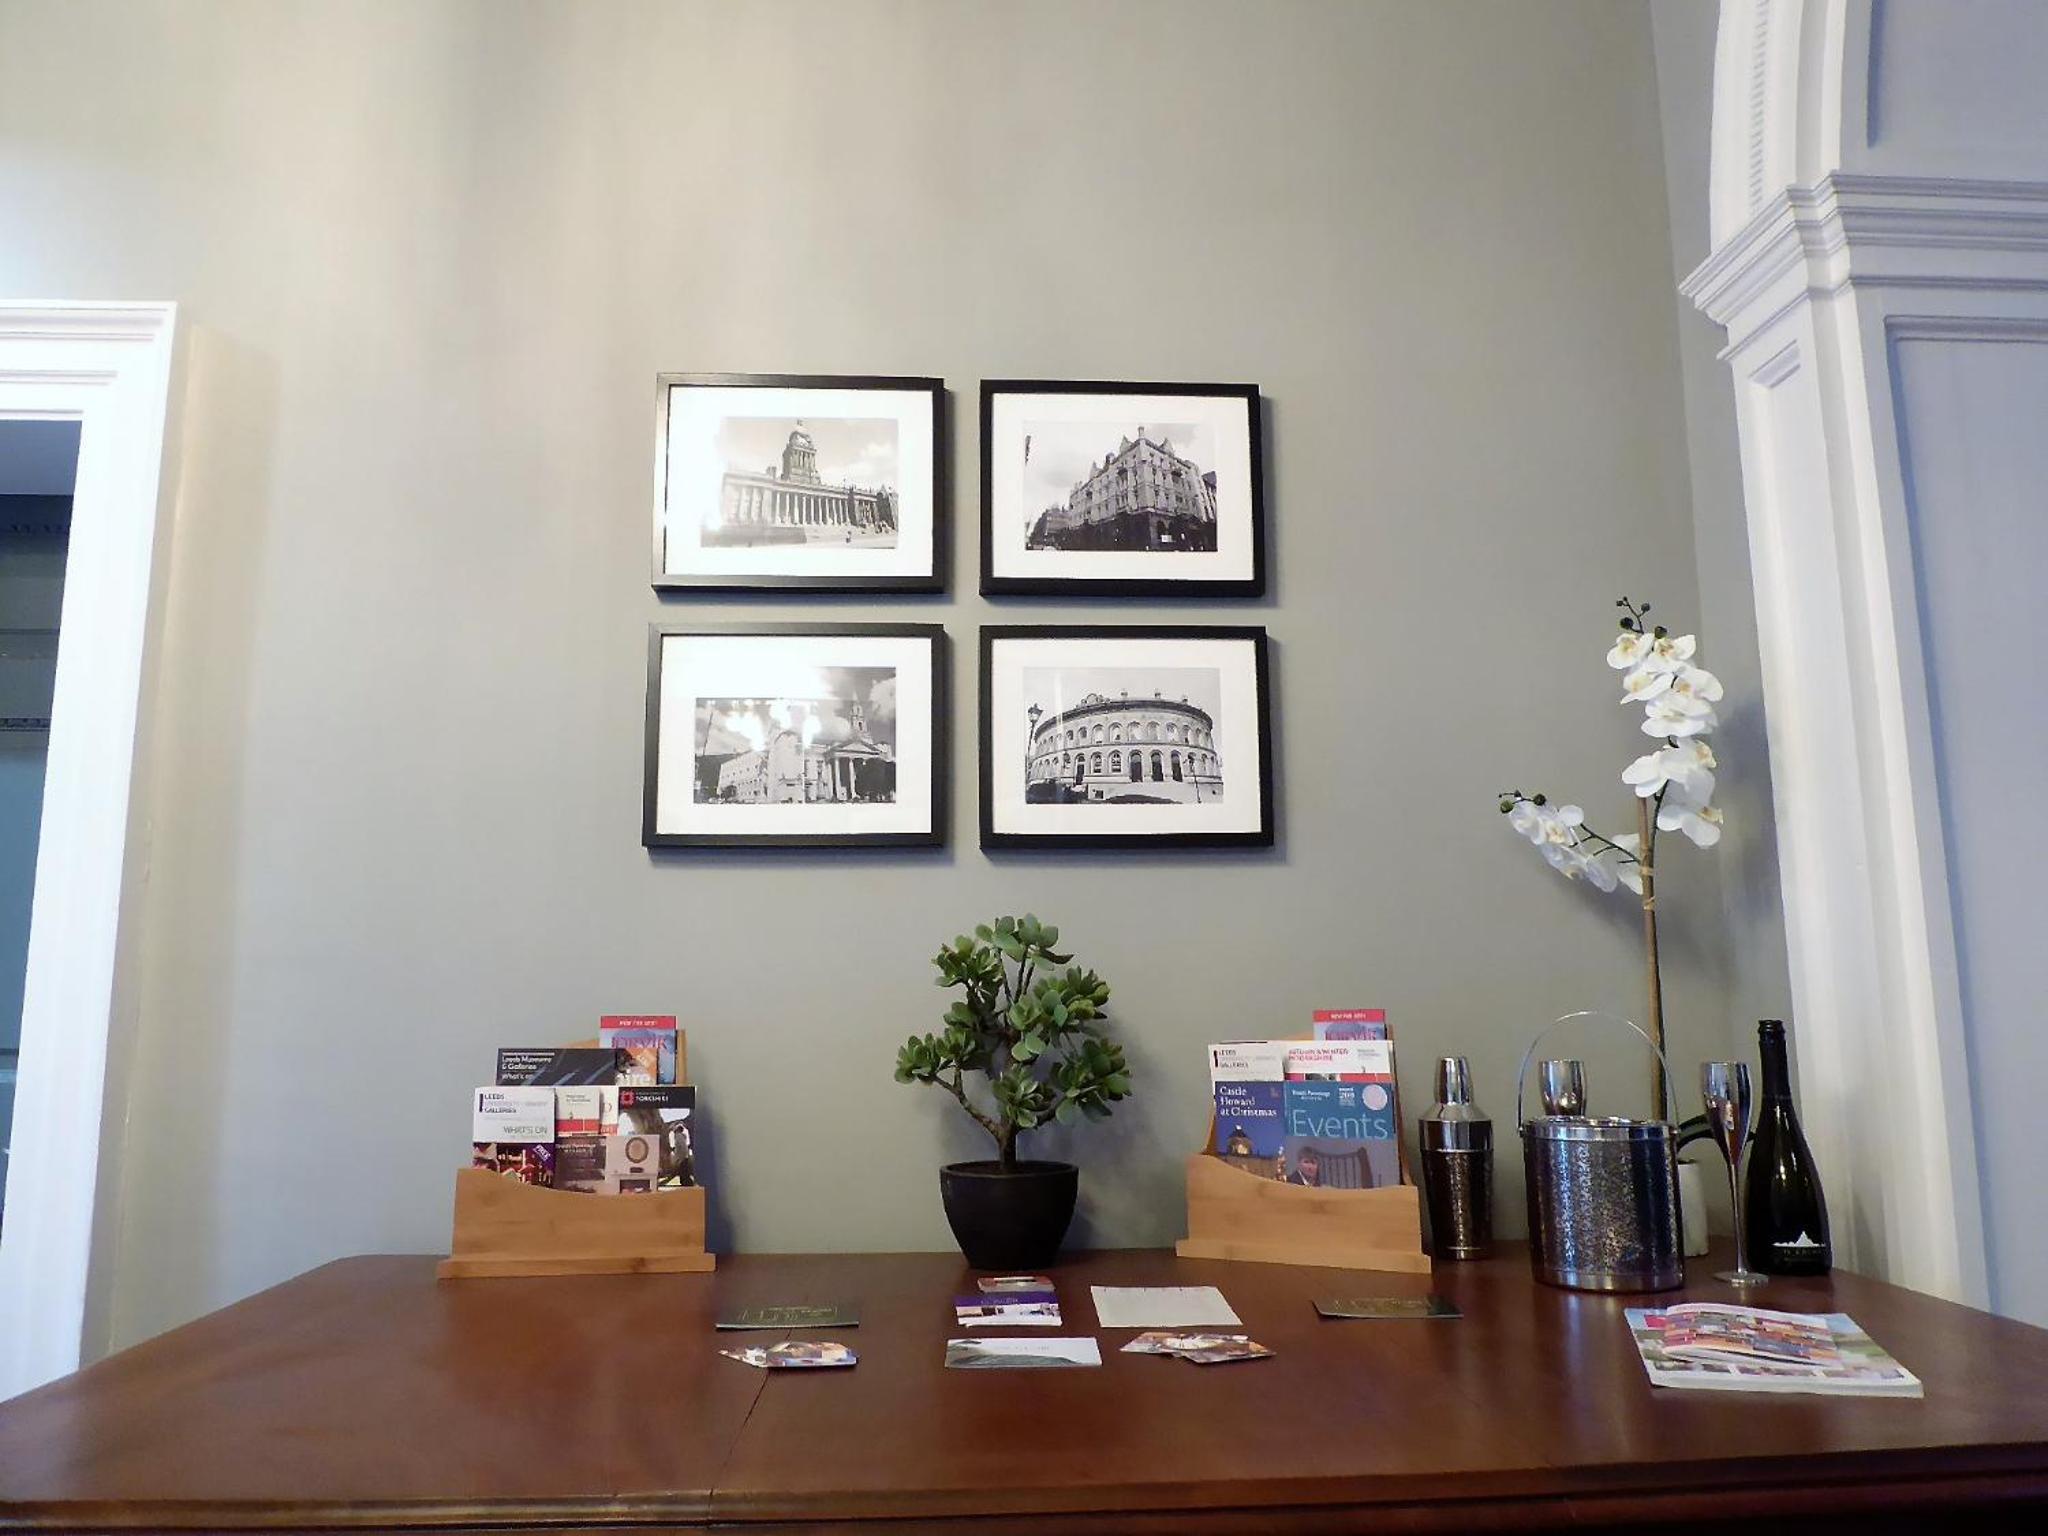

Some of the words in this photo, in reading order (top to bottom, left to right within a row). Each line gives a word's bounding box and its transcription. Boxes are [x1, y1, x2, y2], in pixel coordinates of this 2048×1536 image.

[1220, 1086, 1247, 1096] Castle
[1220, 1096, 1256, 1106] Howard
[1231, 1106, 1277, 1117] Christmas
[1293, 1109, 1388, 1139] Events
